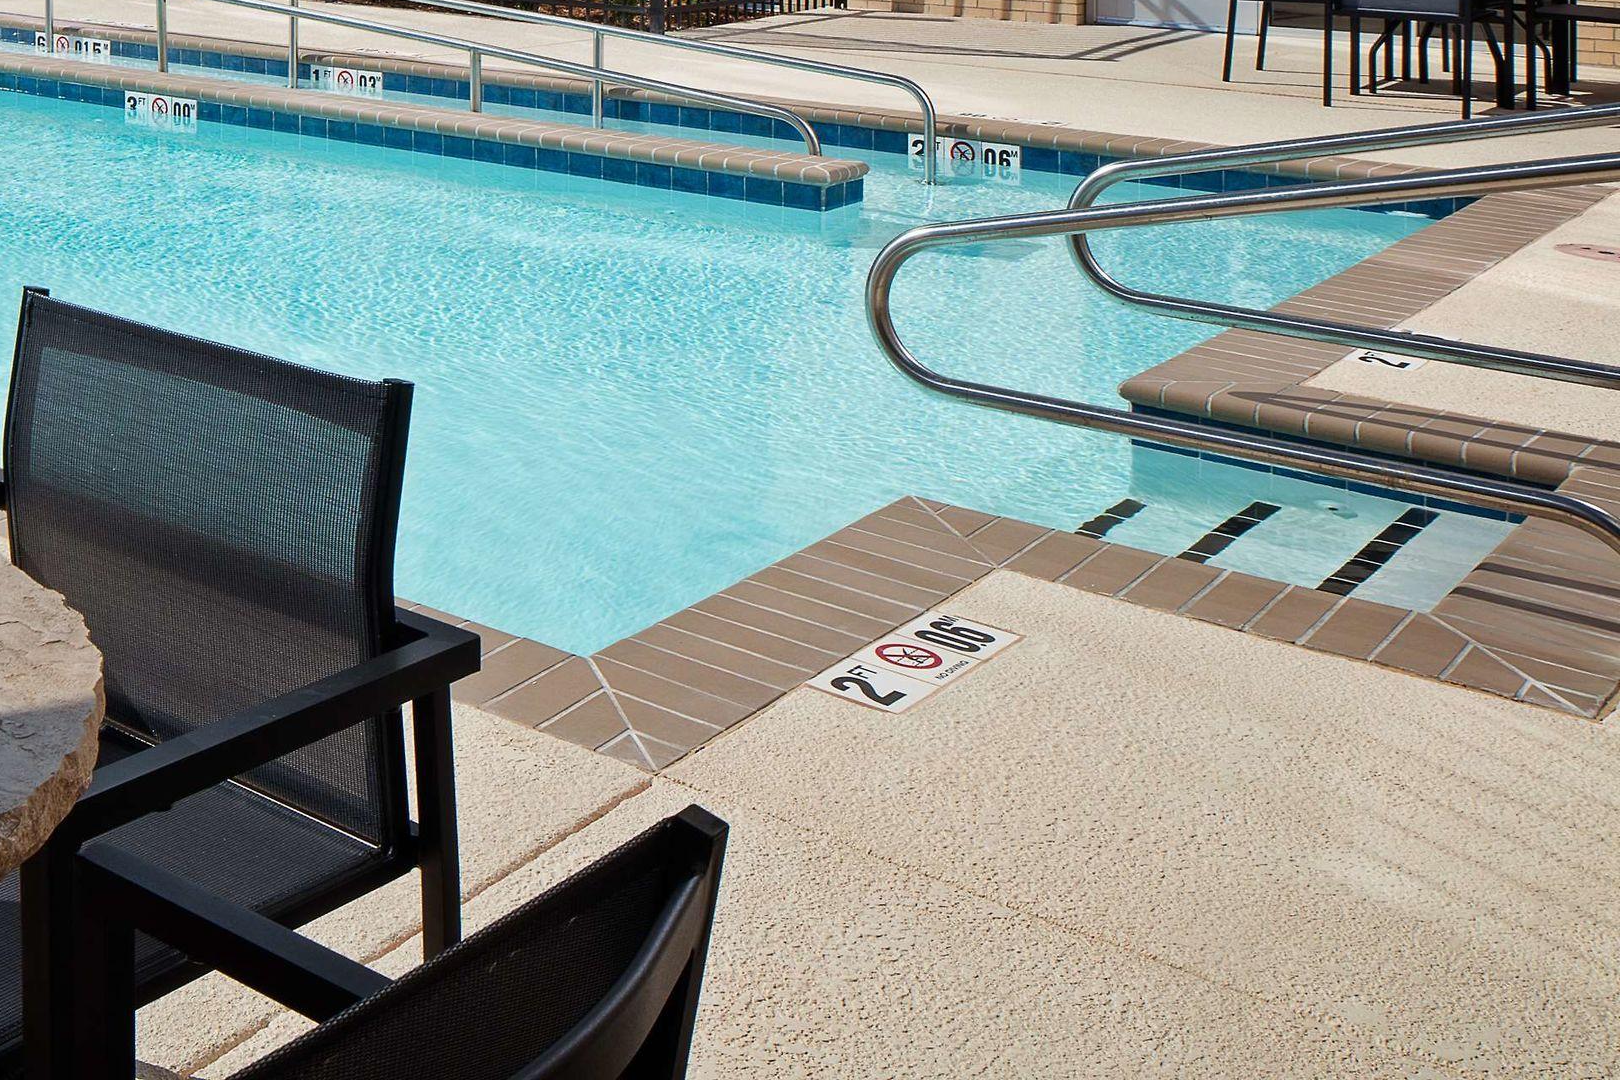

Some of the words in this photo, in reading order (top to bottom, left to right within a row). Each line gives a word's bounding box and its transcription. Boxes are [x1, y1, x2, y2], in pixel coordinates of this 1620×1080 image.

[1358, 355, 1411, 369] 2
[846, 664, 878, 679] FT
[944, 660, 969, 674] DIVING
[830, 676, 908, 707] 2
